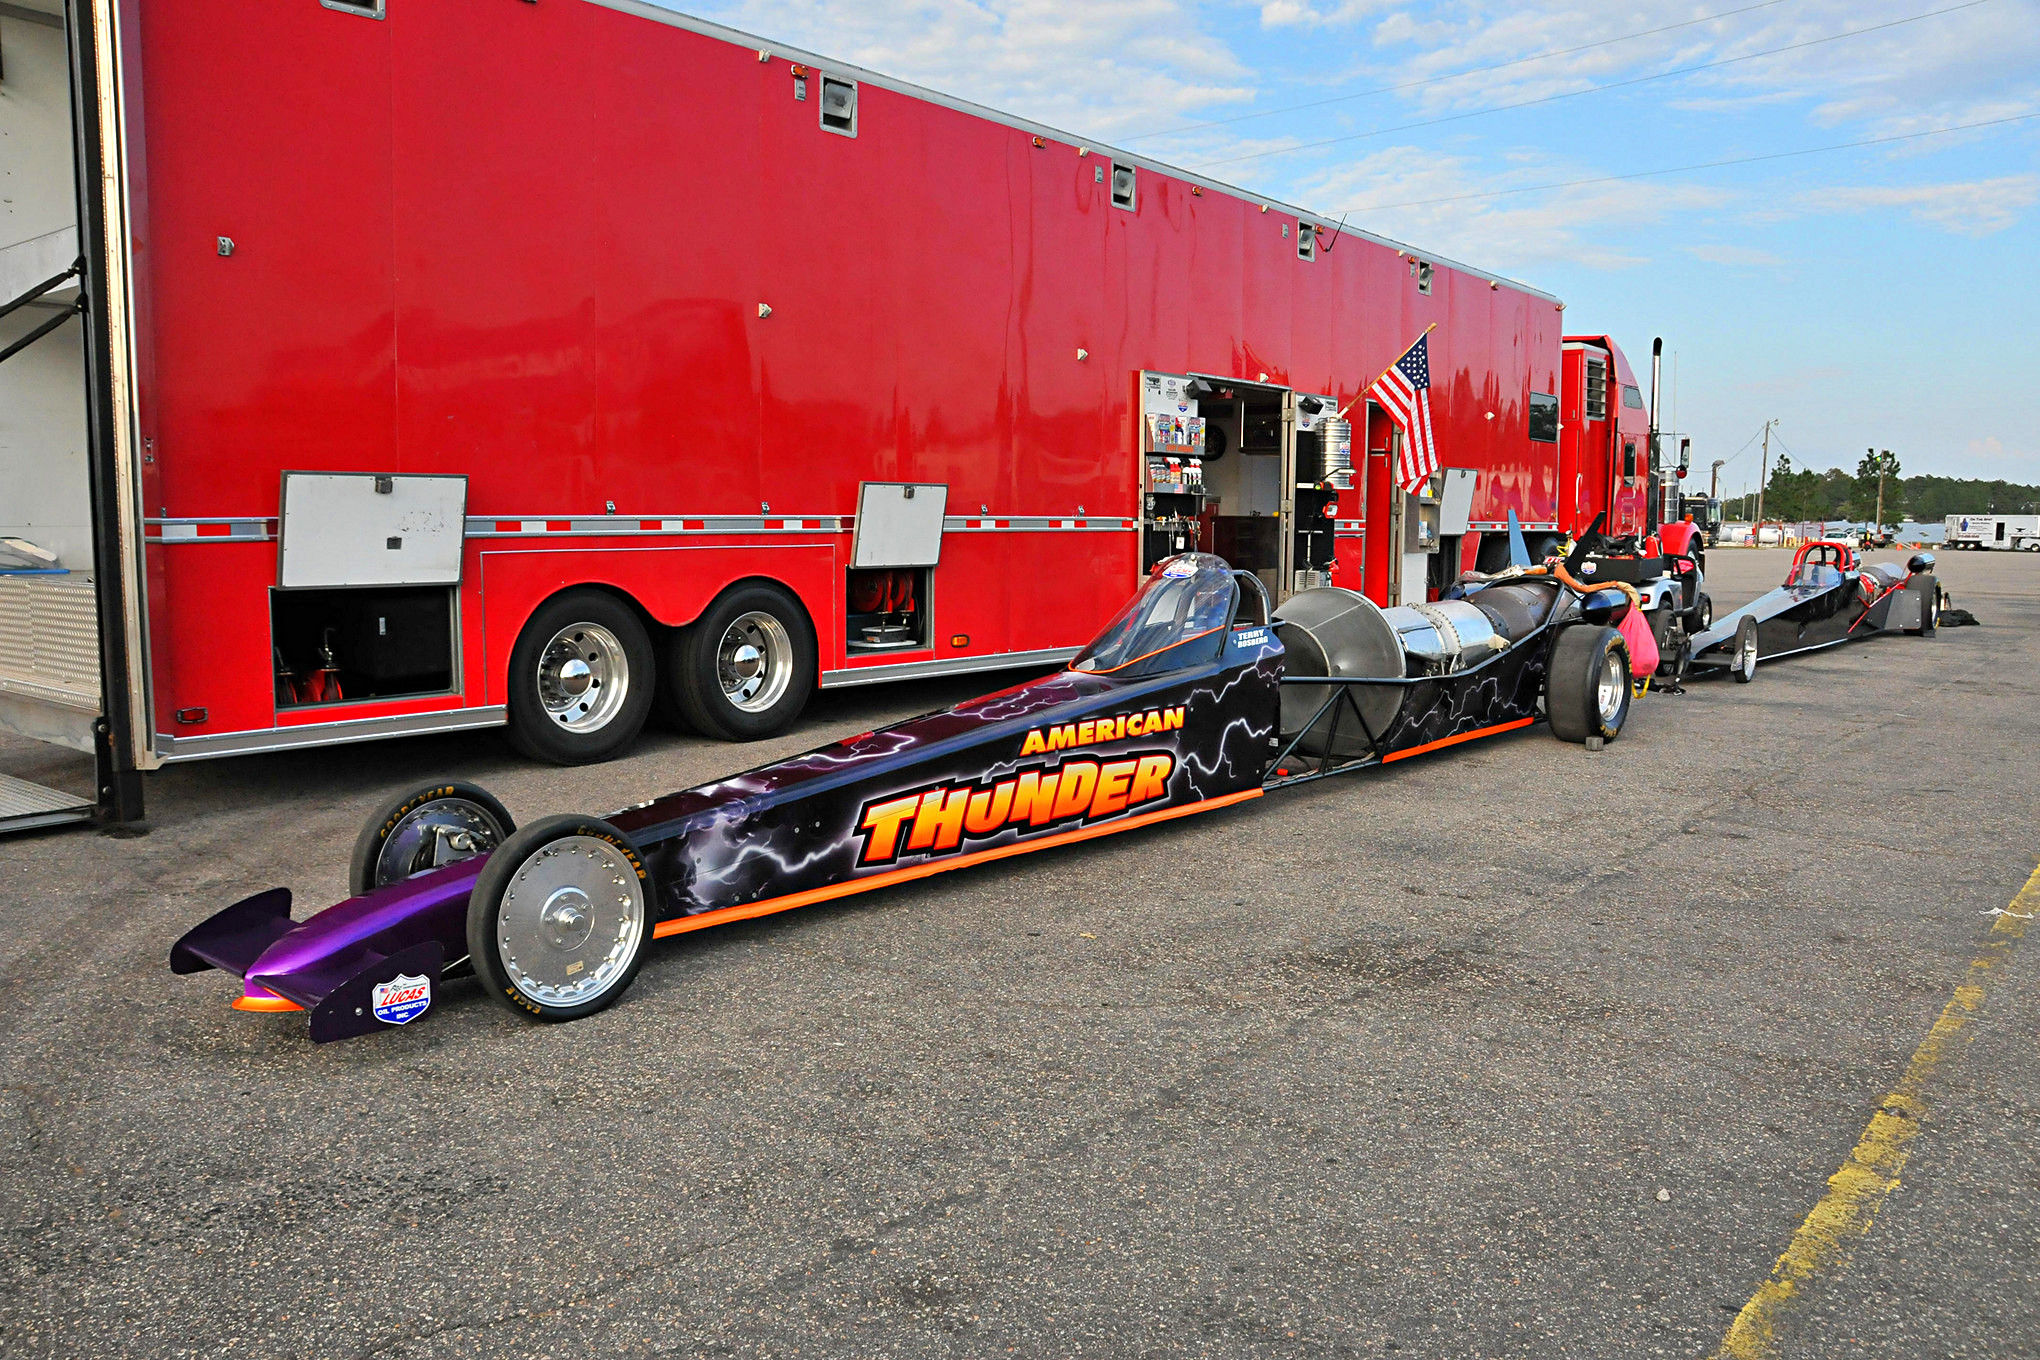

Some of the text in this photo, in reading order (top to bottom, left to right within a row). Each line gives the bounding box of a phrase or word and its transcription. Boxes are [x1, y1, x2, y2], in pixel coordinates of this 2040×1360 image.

[1237, 629, 1264, 641] TERRY
[1019, 706, 1186, 757] AMERICAN
[380, 786, 455, 839] GOODYEAR
[861, 754, 1173, 863] THUNDER
[381, 986, 426, 1006] LUCAS
[391, 1000, 427, 1013] PRODUCTS
